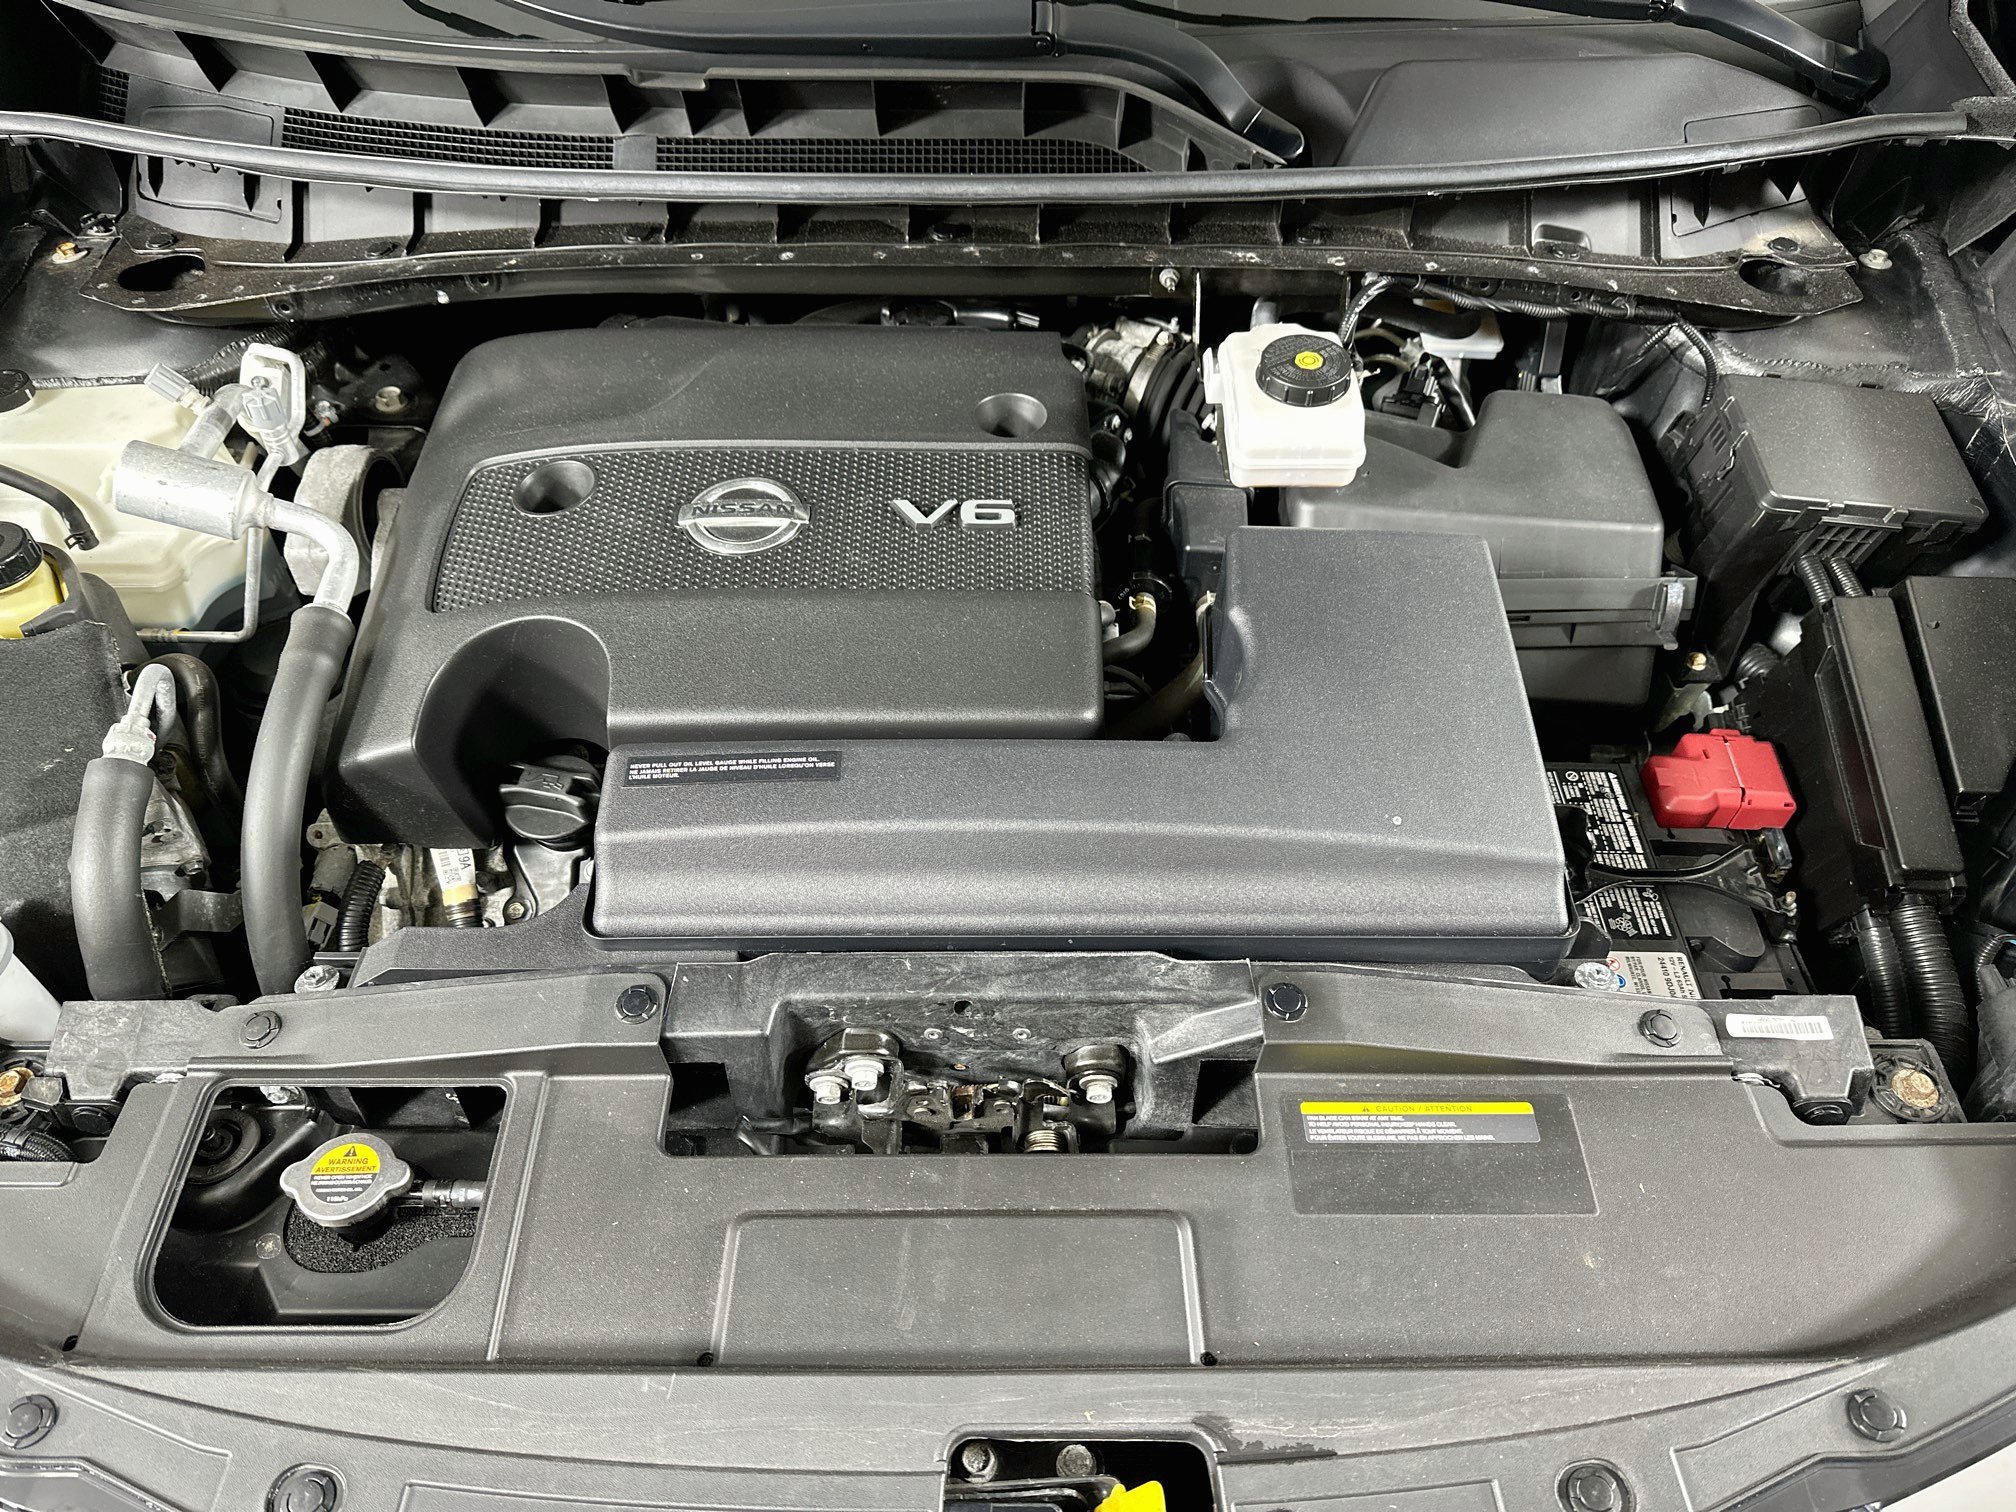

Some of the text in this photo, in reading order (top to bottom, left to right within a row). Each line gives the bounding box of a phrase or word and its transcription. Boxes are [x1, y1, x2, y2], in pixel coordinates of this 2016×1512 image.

[691, 502, 795, 516] NISSAN
[892, 500, 1016, 528] V6
[1658, 957, 1669, 976] 24410
[1668, 957, 1676, 966] 12V
[1677, 957, 1692, 987] RENAULT
[1643, 979, 1651, 993] NISSAN
